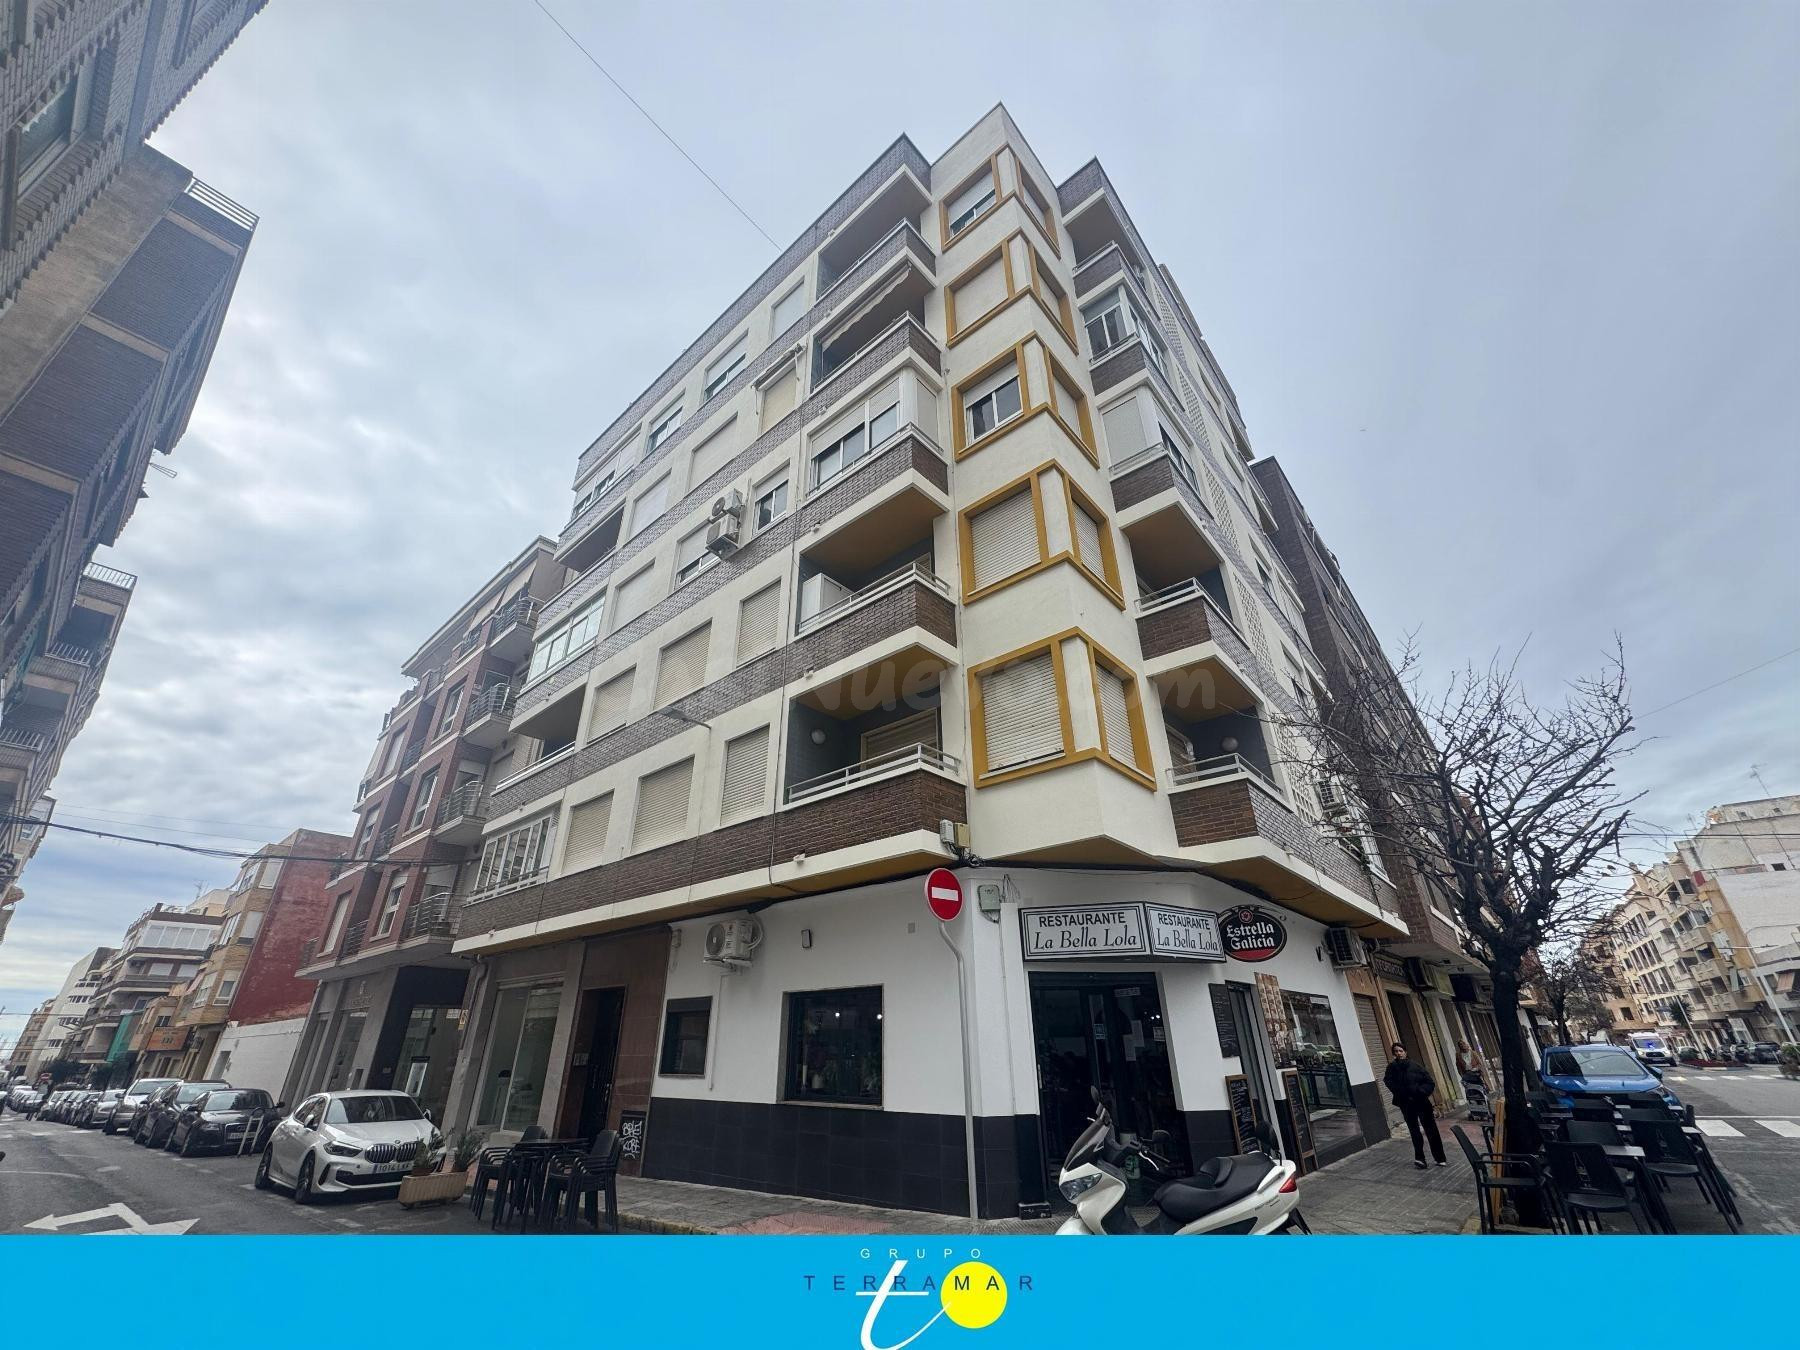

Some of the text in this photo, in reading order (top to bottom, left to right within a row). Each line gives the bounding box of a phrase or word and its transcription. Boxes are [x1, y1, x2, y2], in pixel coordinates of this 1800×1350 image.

[1039, 911, 1126, 927] RESTAURANTE
[1157, 912, 1211, 930] RESTAURANTE
[1033, 924, 1137, 950] La Bella Lola
[1226, 922, 1275, 938] Estrella
[1156, 928, 1219, 952] La Bella Lola
[1230, 934, 1275, 950] Galicia
